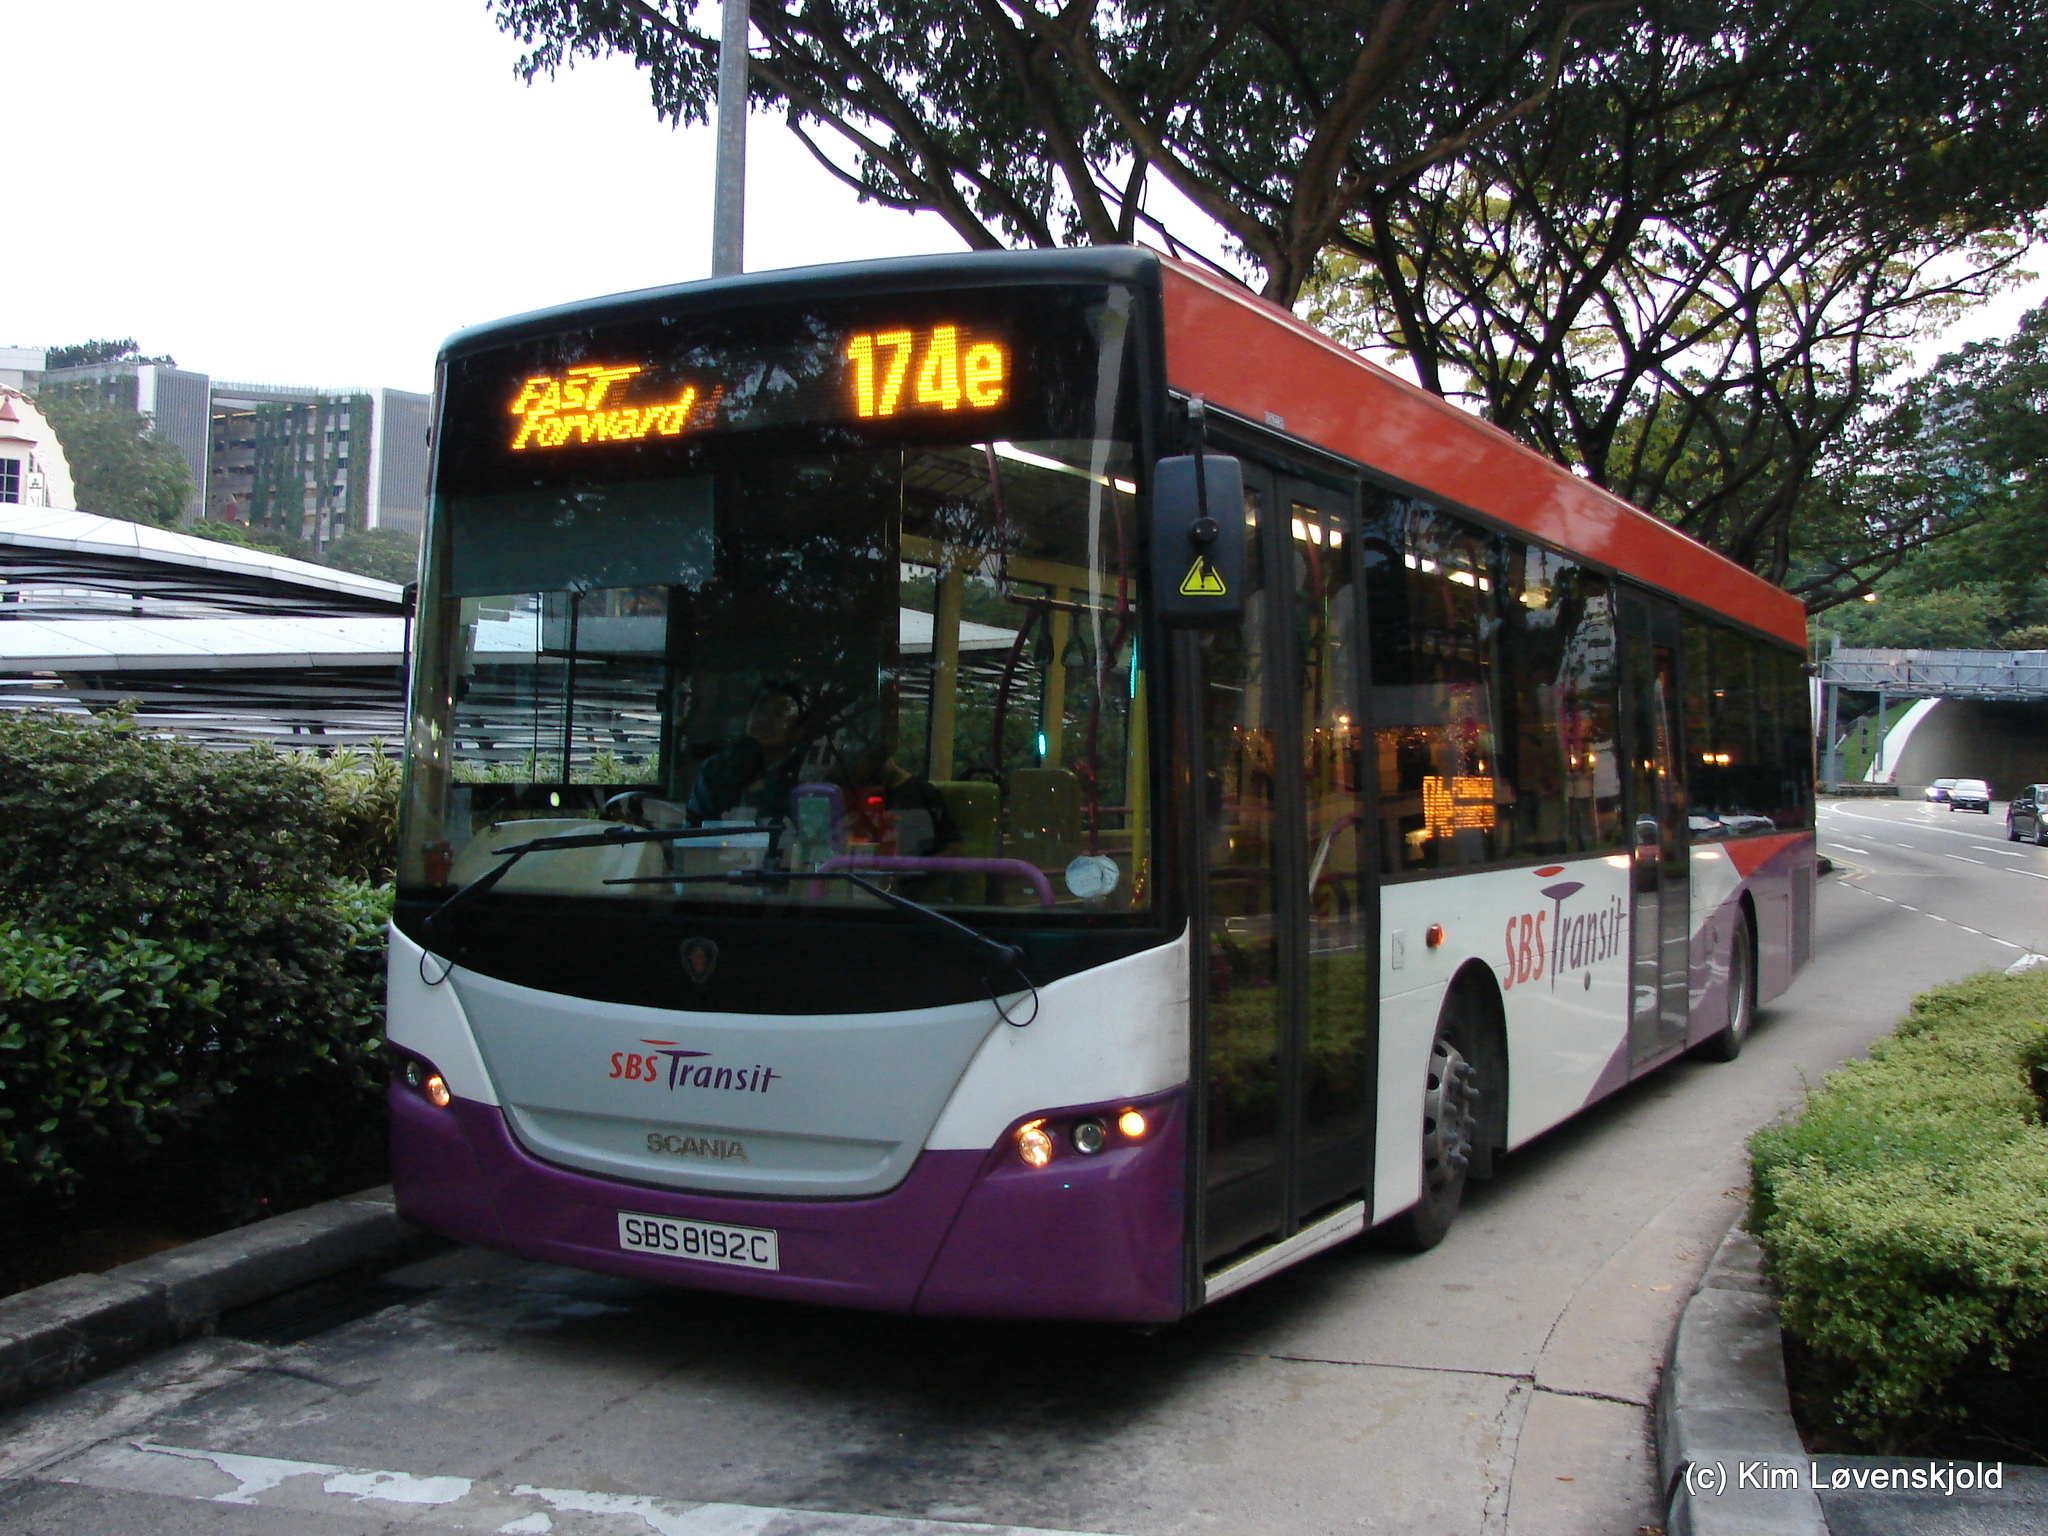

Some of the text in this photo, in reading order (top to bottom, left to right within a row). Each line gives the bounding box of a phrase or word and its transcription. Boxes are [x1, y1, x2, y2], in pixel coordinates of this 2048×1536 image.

[511, 366, 641, 414] FAST
[847, 326, 1003, 417] 174e
[1503, 881, 1627, 993] SBS Transit
[609, 1050, 782, 1093] SBS Transit
[646, 1132, 750, 1164] SCANIA
[625, 1218, 769, 1264] SBS8192C
